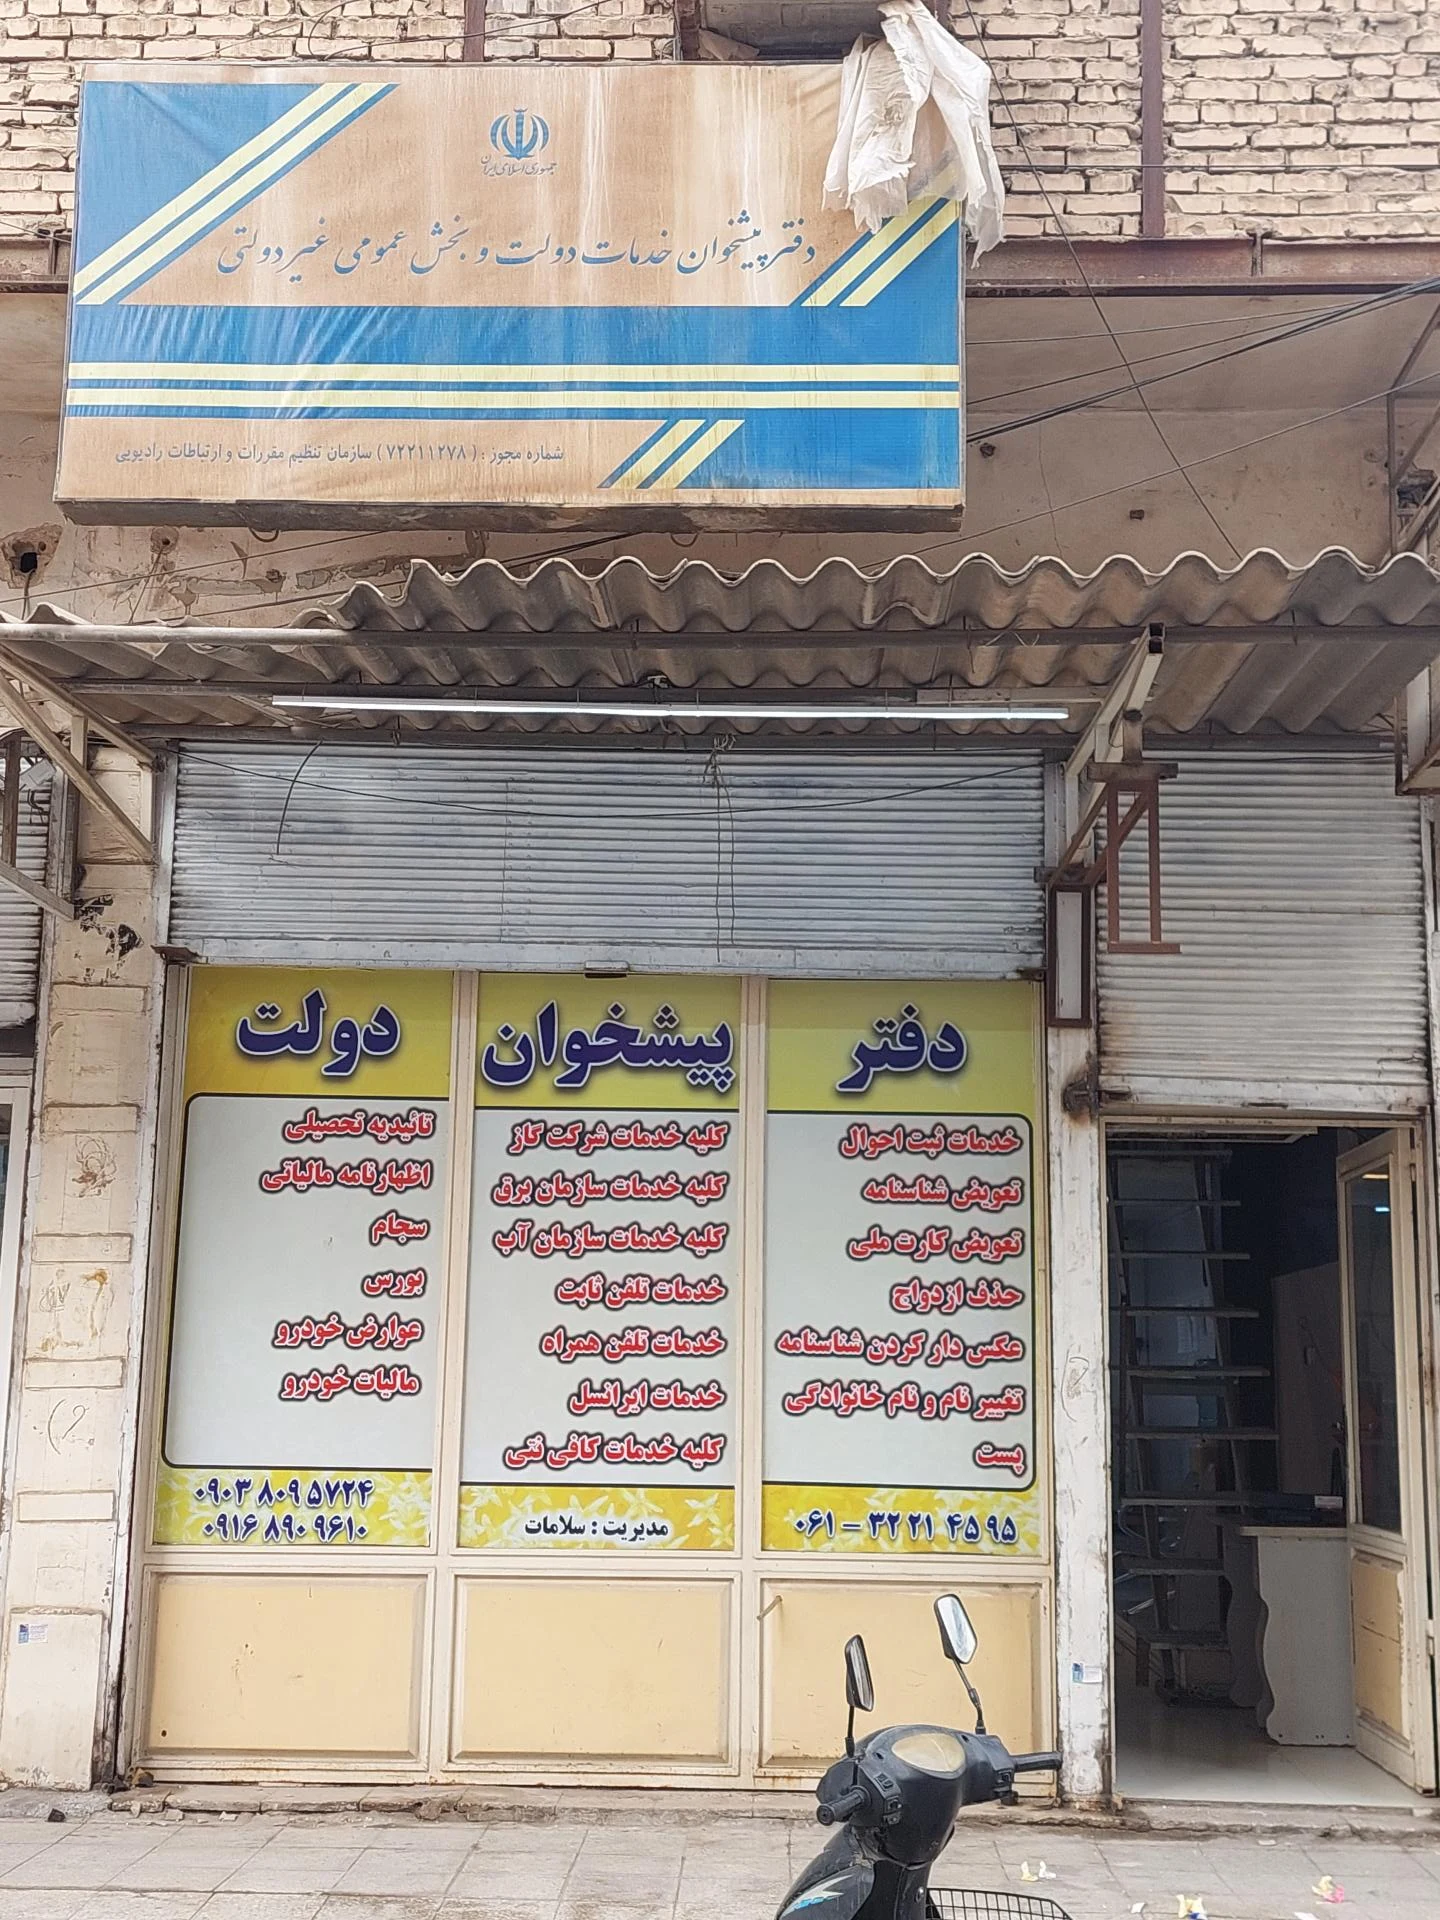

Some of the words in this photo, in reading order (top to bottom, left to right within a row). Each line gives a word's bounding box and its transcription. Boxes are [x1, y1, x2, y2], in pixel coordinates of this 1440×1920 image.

[334, 230, 407, 275] عمومی
[410, 214, 469, 275] بخش
[473, 247, 488, 265] و
[495, 232, 576, 265] دولت
[581, 229, 672, 265] خدمات
[676, 209, 769, 275] پیشخوان
[756, 217, 816, 273] دفتر
[115, 443, 163, 463] رادیویی
[168, 443, 222, 463] ارتباطات
[225, 450, 233, 463] و
[237, 444, 284, 463] مقررات
[288, 446, 321, 468] تنظیم
[326, 444, 372, 463] سازمان
[489, 450, 522, 465] مجوز
[526, 445, 564, 463] شماره
[236, 987, 401, 1076] دولت
[481, 1000, 736, 1092] پیشخوان
[836, 1003, 967, 1092] دفتر
[284, 1110, 365, 1141] تحصیلی
[509, 1122, 544, 1154] گاز
[545, 1122, 610, 1154] شرکت
[611, 1123, 683, 1149] خدمات
[686, 1123, 728, 1155] کلیه
[841, 1125, 905, 1158] احوال
[946, 1128, 1020, 1154] خدمات
[906, 1126, 945, 1158] ثبت
[261, 1160, 335, 1191] مالیاتی
[493, 1176, 533, 1206] برق
[534, 1173, 608, 1206] سازمان
[608, 1173, 682, 1200] خدمات
[684, 1174, 727, 1205] کلیه
[863, 1177, 949, 1203] شناسنامه
[951, 1180, 1022, 1211] تعویض
[371, 1213, 428, 1244] سجام
[494, 1220, 532, 1256] آب
[532, 1224, 607, 1257] سازمان
[608, 1224, 681, 1251] خدمات
[684, 1225, 726, 1257] کلیه
[848, 1228, 892, 1259] ملی
[893, 1228, 949, 1261] کارت
[951, 1231, 1023, 1262] تعویض
[363, 1271, 426, 1297] بورس
[557, 1275, 604, 1309] ثابت
[604, 1275, 650, 1309] تلفن
[651, 1277, 725, 1303] خدمات
[892, 1279, 965, 1314] ازدواج
[965, 1281, 1023, 1308] حذف
[275, 1315, 344, 1347] خودرو
[345, 1316, 422, 1348] عوارض
[541, 1327, 602, 1362] همراه
[602, 1328, 650, 1362] تلفن
[650, 1328, 724, 1355] خدمات
[777, 1329, 864, 1356] شناسنامه
[866, 1332, 926, 1364] کردن
[929, 1333, 964, 1366] دار
[965, 1334, 1023, 1366] عکس
[282, 1367, 351, 1399] خودرو
[352, 1367, 419, 1398] مالیات
[569, 1380, 649, 1415] ایرانسل
[650, 1381, 724, 1408] خدمات
[784, 1381, 885, 1414] خانوادگی
[887, 1383, 920, 1417] نام
[922, 1393, 938, 1418] و
[939, 1385, 972, 1418] نام
[973, 1386, 1025, 1419] تغییر
[504, 1435, 545, 1468] نتی
[546, 1434, 601, 1469] کافی
[603, 1436, 678, 1464] خدمات
[681, 1436, 725, 1469] کلیه
[974, 1445, 1025, 1476] پست
[194, 1477, 253, 1507] ۰۹۰۳
[256, 1477, 301, 1507] ۸۰۹
[305, 1478, 374, 1508] ۵۷۲۴
[203, 1512, 259, 1541] ۰۹۱۶
[263, 1513, 307, 1542] ۸۹۰
[312, 1514, 368, 1542] ۹۶۱۰
[524, 1514, 586, 1536] سلامات
[603, 1521, 669, 1542] مدیریت
